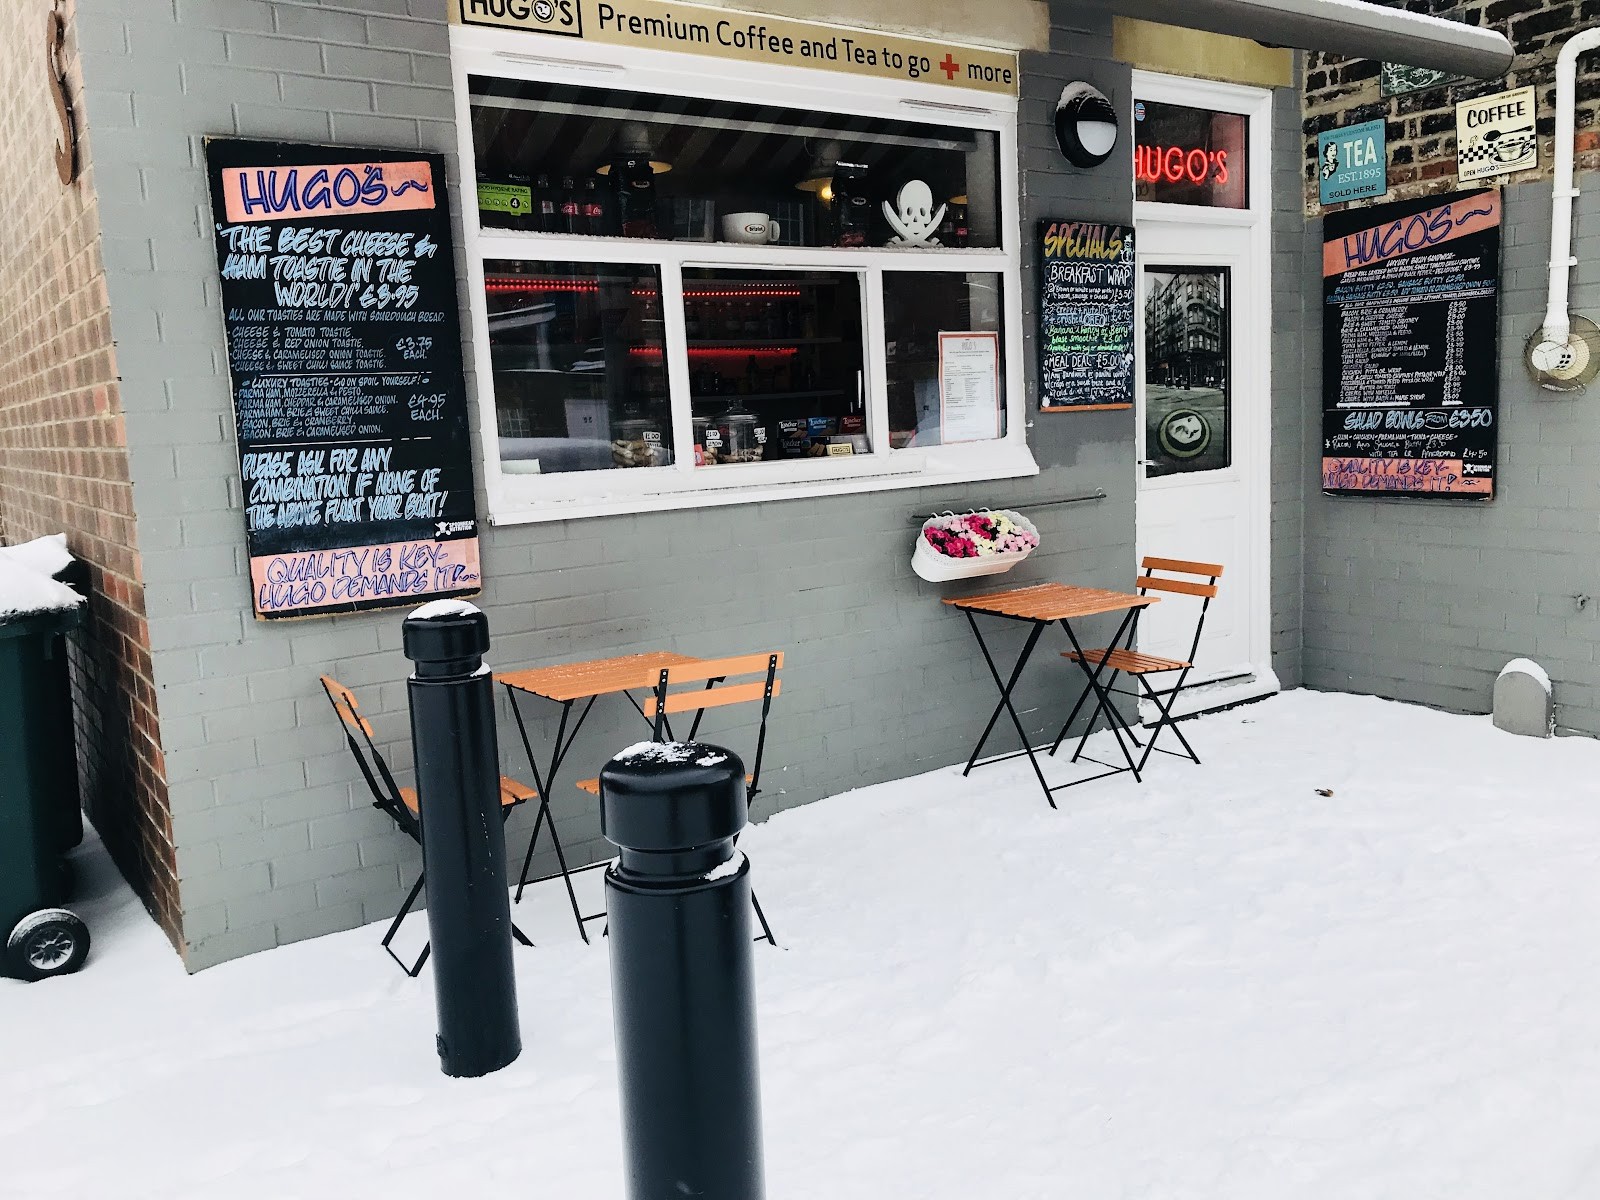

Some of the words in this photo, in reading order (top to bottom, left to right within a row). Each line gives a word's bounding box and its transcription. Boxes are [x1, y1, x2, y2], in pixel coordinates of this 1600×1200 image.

[598, 2, 709, 43] Premium
[716, 20, 793, 54] Coffee
[800, 37, 837, 60] and
[841, 38, 877, 66] Tea
[882, 47, 903, 68] to
[908, 55, 930, 78] go
[967, 61, 1012, 84] more
[1467, 100, 1526, 128] COFFEE
[1343, 136, 1378, 169] TEA
[239, 165, 388, 214] HUGO'S
[1329, 189, 1352, 199] SOLD
[1353, 184, 1377, 195] HERE
[277, 227, 342, 254] BEST
[340, 230, 414, 257] CHEESE
[1044, 223, 1123, 261] SPECIALS
[1343, 205, 1452, 267] HUGO'S
[222, 254, 266, 280] HAM
[269, 255, 349, 282] TOASTIE
[351, 258, 372, 283] IN
[376, 259, 417, 284] THE
[1049, 265, 1105, 284] BREAKFAST
[1107, 268, 1130, 286] WRAP
[229, 308, 245, 321] ALL
[248, 309, 265, 321] OUR
[267, 309, 303, 321] TOASTIES
[306, 310, 322, 321] ARE
[324, 310, 347, 321] MADE
[348, 310, 367, 321] WITH
[232, 326, 270, 338] CHEESE
[273, 326, 280, 337] &
[284, 327, 315, 337] TOMATO
[232, 338, 269, 348] CHEESE
[284, 338, 302, 348] RED
[304, 339, 330, 348] ONION
[232, 350, 263, 360] CHEESE
[273, 349, 326, 360] CARAMELISED
[328, 350, 353, 359] ONION
[1048, 355, 1070, 368] MEAL
[1071, 355, 1092, 368] DEAL
[234, 361, 264, 371] CHEESE
[277, 361, 303, 370] SWEET
[252, 376, 289, 388] LUXURY
[346, 377, 358, 386] ON
[358, 377, 380, 387] SPOIL
[238, 388, 264, 399] PARMA
[238, 399, 264, 410] PARMA
[286, 408, 306, 417] BRIE
[314, 407, 339, 417] SWEET
[272, 418, 291, 428] BRIE
[1343, 411, 1383, 431] SALAD
[1385, 409, 1425, 431] BOWLS
[1425, 414, 1448, 425] FROM
[275, 427, 295, 438] BRIE
[242, 451, 294, 481] PLEASE
[298, 449, 325, 475] ASK
[330, 448, 359, 473] FOR
[361, 447, 392, 473] ANY
[1327, 459, 1393, 475] QUALITY
[1397, 459, 1411, 475] IS
[249, 472, 350, 504] COMBINATION
[355, 472, 374, 496] IF
[376, 470, 416, 494] NONE
[421, 468, 442, 493] OF
[1322, 474, 1357, 489] HUGO
[1362, 475, 1424, 490] DEMANDS
[246, 503, 277, 530] THE
[277, 500, 323, 529] ABOVE
[324, 497, 365, 527] FLOAT
[368, 497, 403, 521] YOUR
[404, 491, 449, 521] BOAT!
[267, 549, 369, 585] QUALITY
[372, 548, 392, 573] IS
[259, 582, 326, 609] HUGO
[332, 570, 428, 599] DEMANDS
